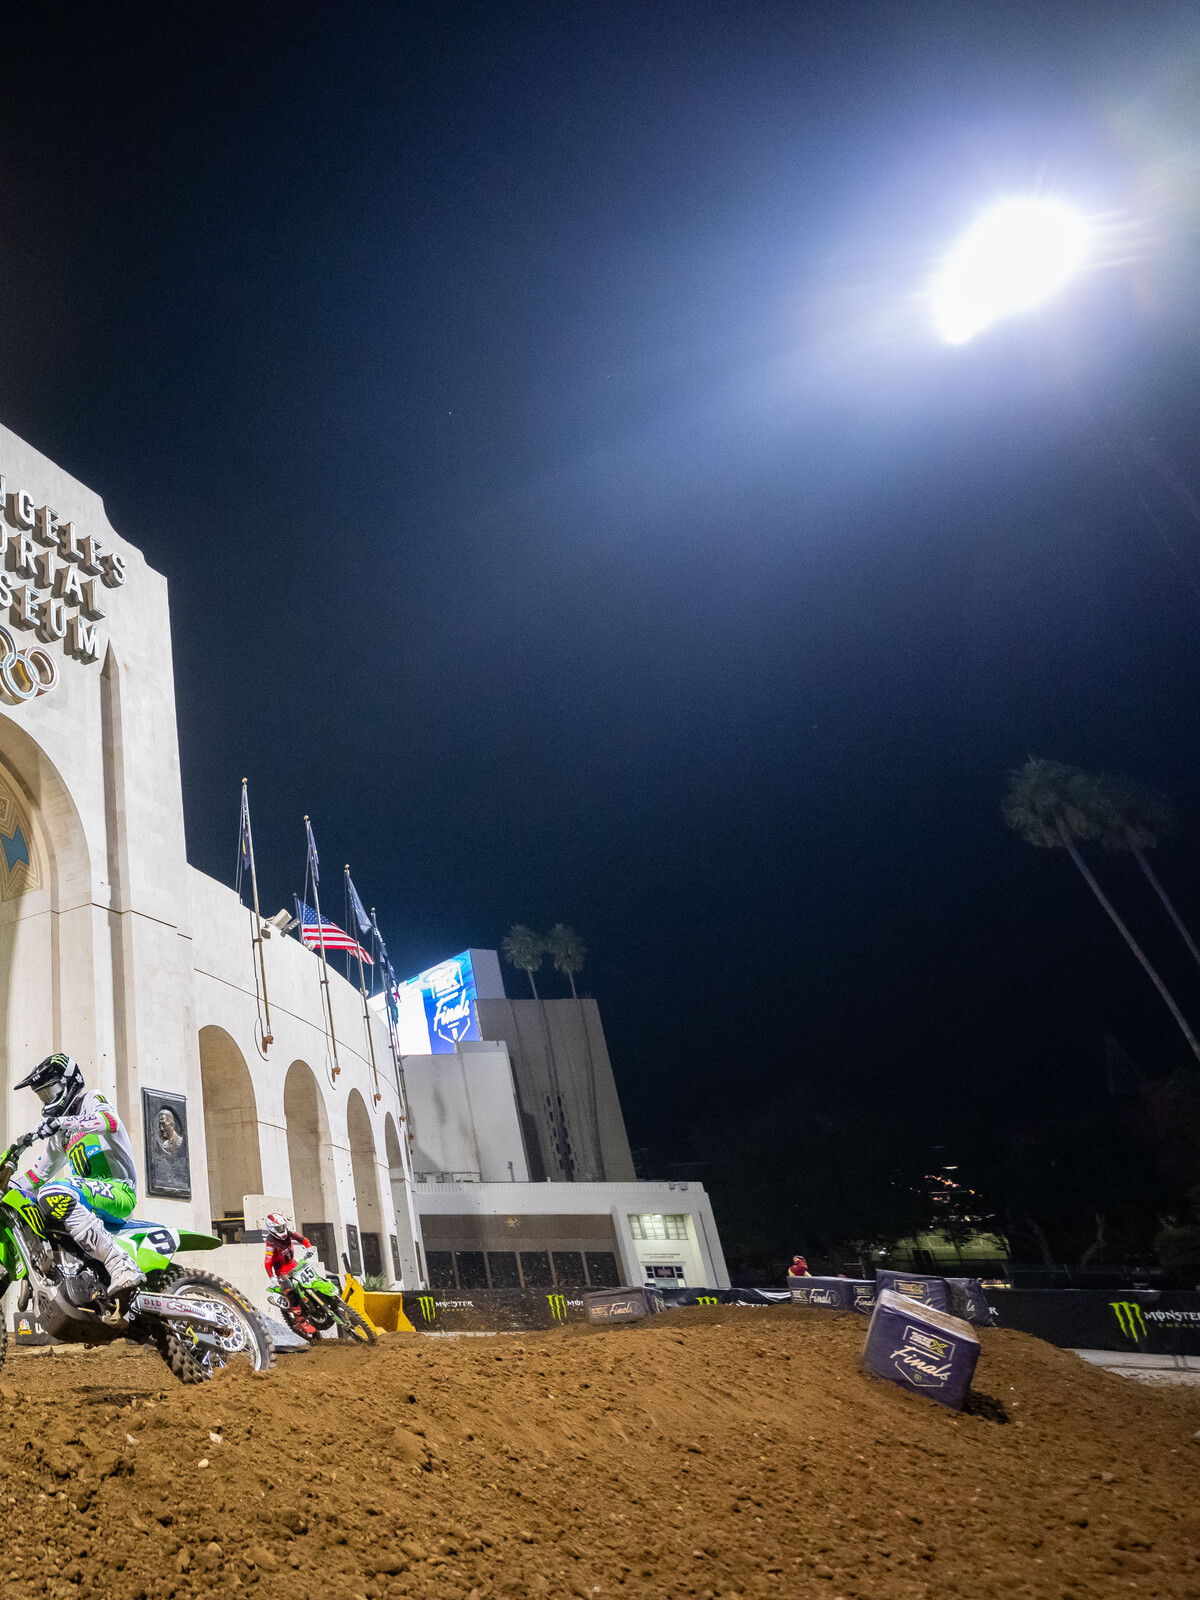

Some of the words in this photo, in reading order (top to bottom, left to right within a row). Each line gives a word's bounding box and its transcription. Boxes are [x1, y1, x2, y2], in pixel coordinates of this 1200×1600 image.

[433, 988, 470, 1032] Finals
[66, 1176, 115, 1200] FOX
[147, 1229, 177, 1256] 9
[300, 1266, 315, 1285] 45
[809, 1288, 831, 1305] Finals
[609, 1302, 633, 1316] Finals
[889, 1345, 952, 1381] Finals
